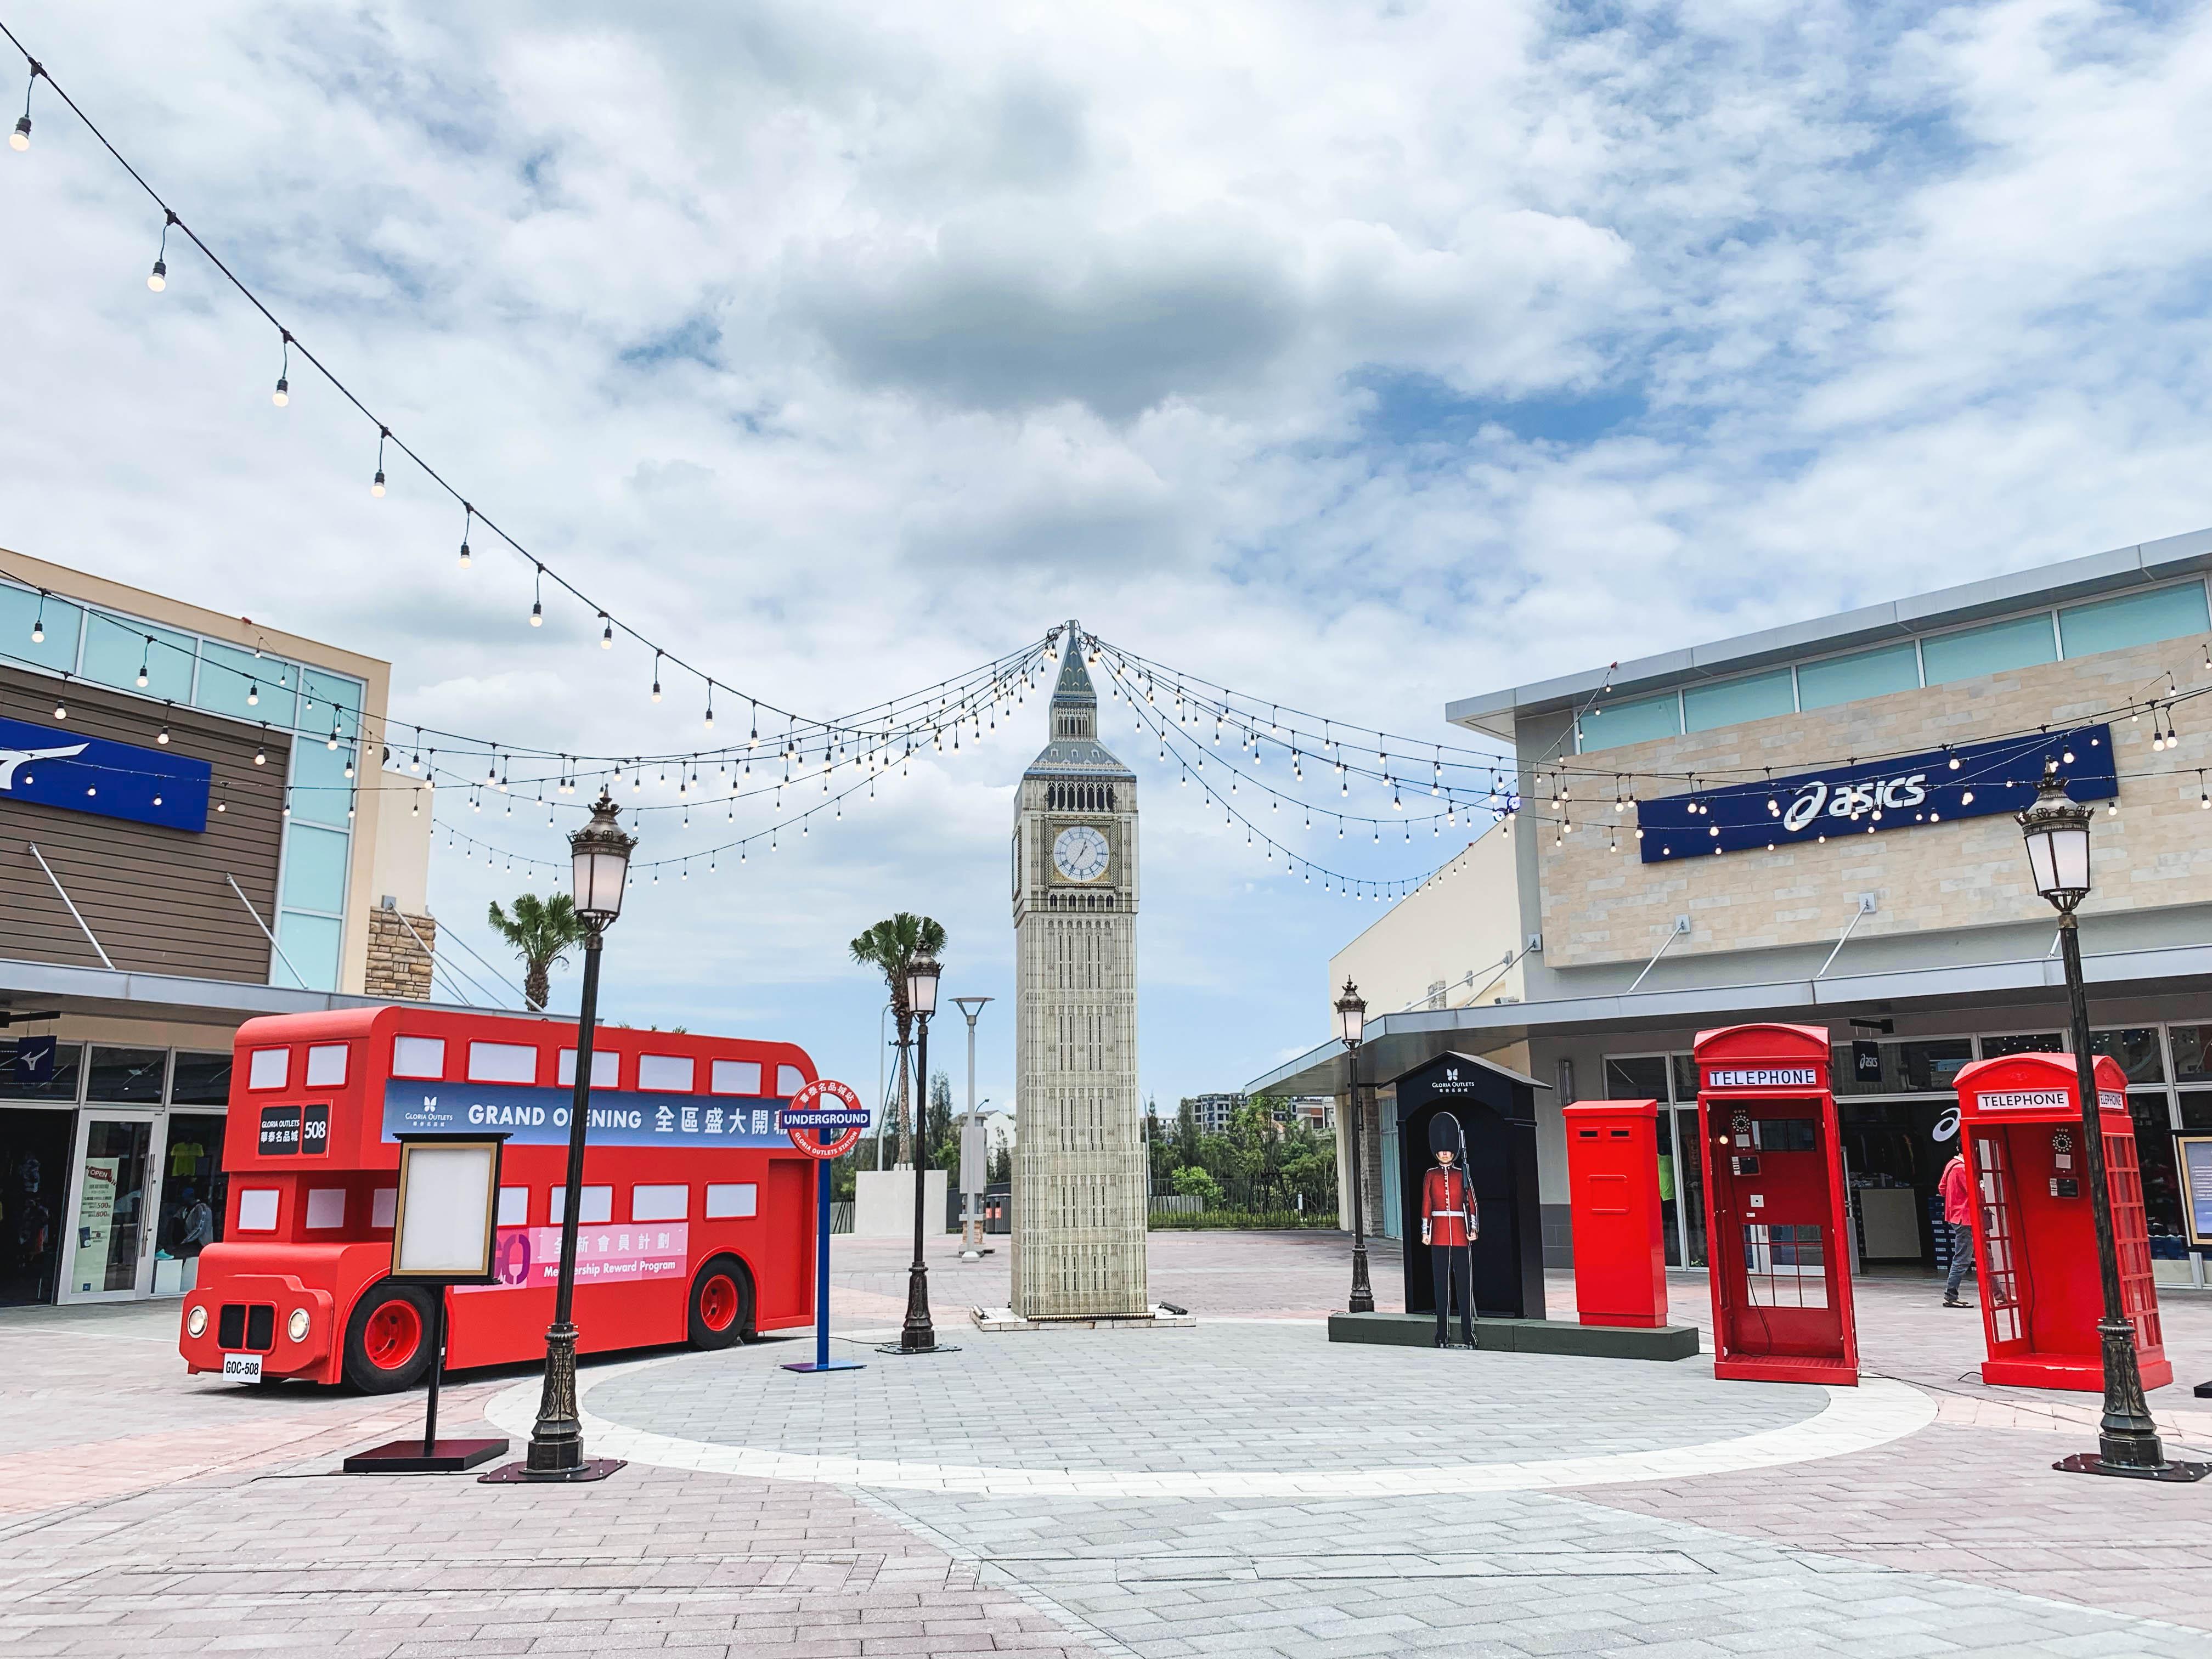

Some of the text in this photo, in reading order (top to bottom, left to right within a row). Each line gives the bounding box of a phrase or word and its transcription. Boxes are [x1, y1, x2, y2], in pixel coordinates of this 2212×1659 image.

[1711, 1070, 1815, 1085] TELEPHONE
[1982, 1093, 2065, 1107] TELEPHONE
[2100, 1094, 2121, 1106] ELEPHONE
[468, 1104, 642, 1128] GRAND ONING
[784, 1113, 868, 1125] UNDERGROUND
[261, 1119, 300, 1128] GLORIA OUTLETS
[304, 1121, 326, 1139] 508
[795, 1132, 811, 1151] GLORIA
[838, 1131, 858, 1152] STATION
[90, 1169, 108, 1177] OPEN
[544, 1260, 676, 1277] Meership Reward Program
[225, 1361, 259, 1375] GOC-508
